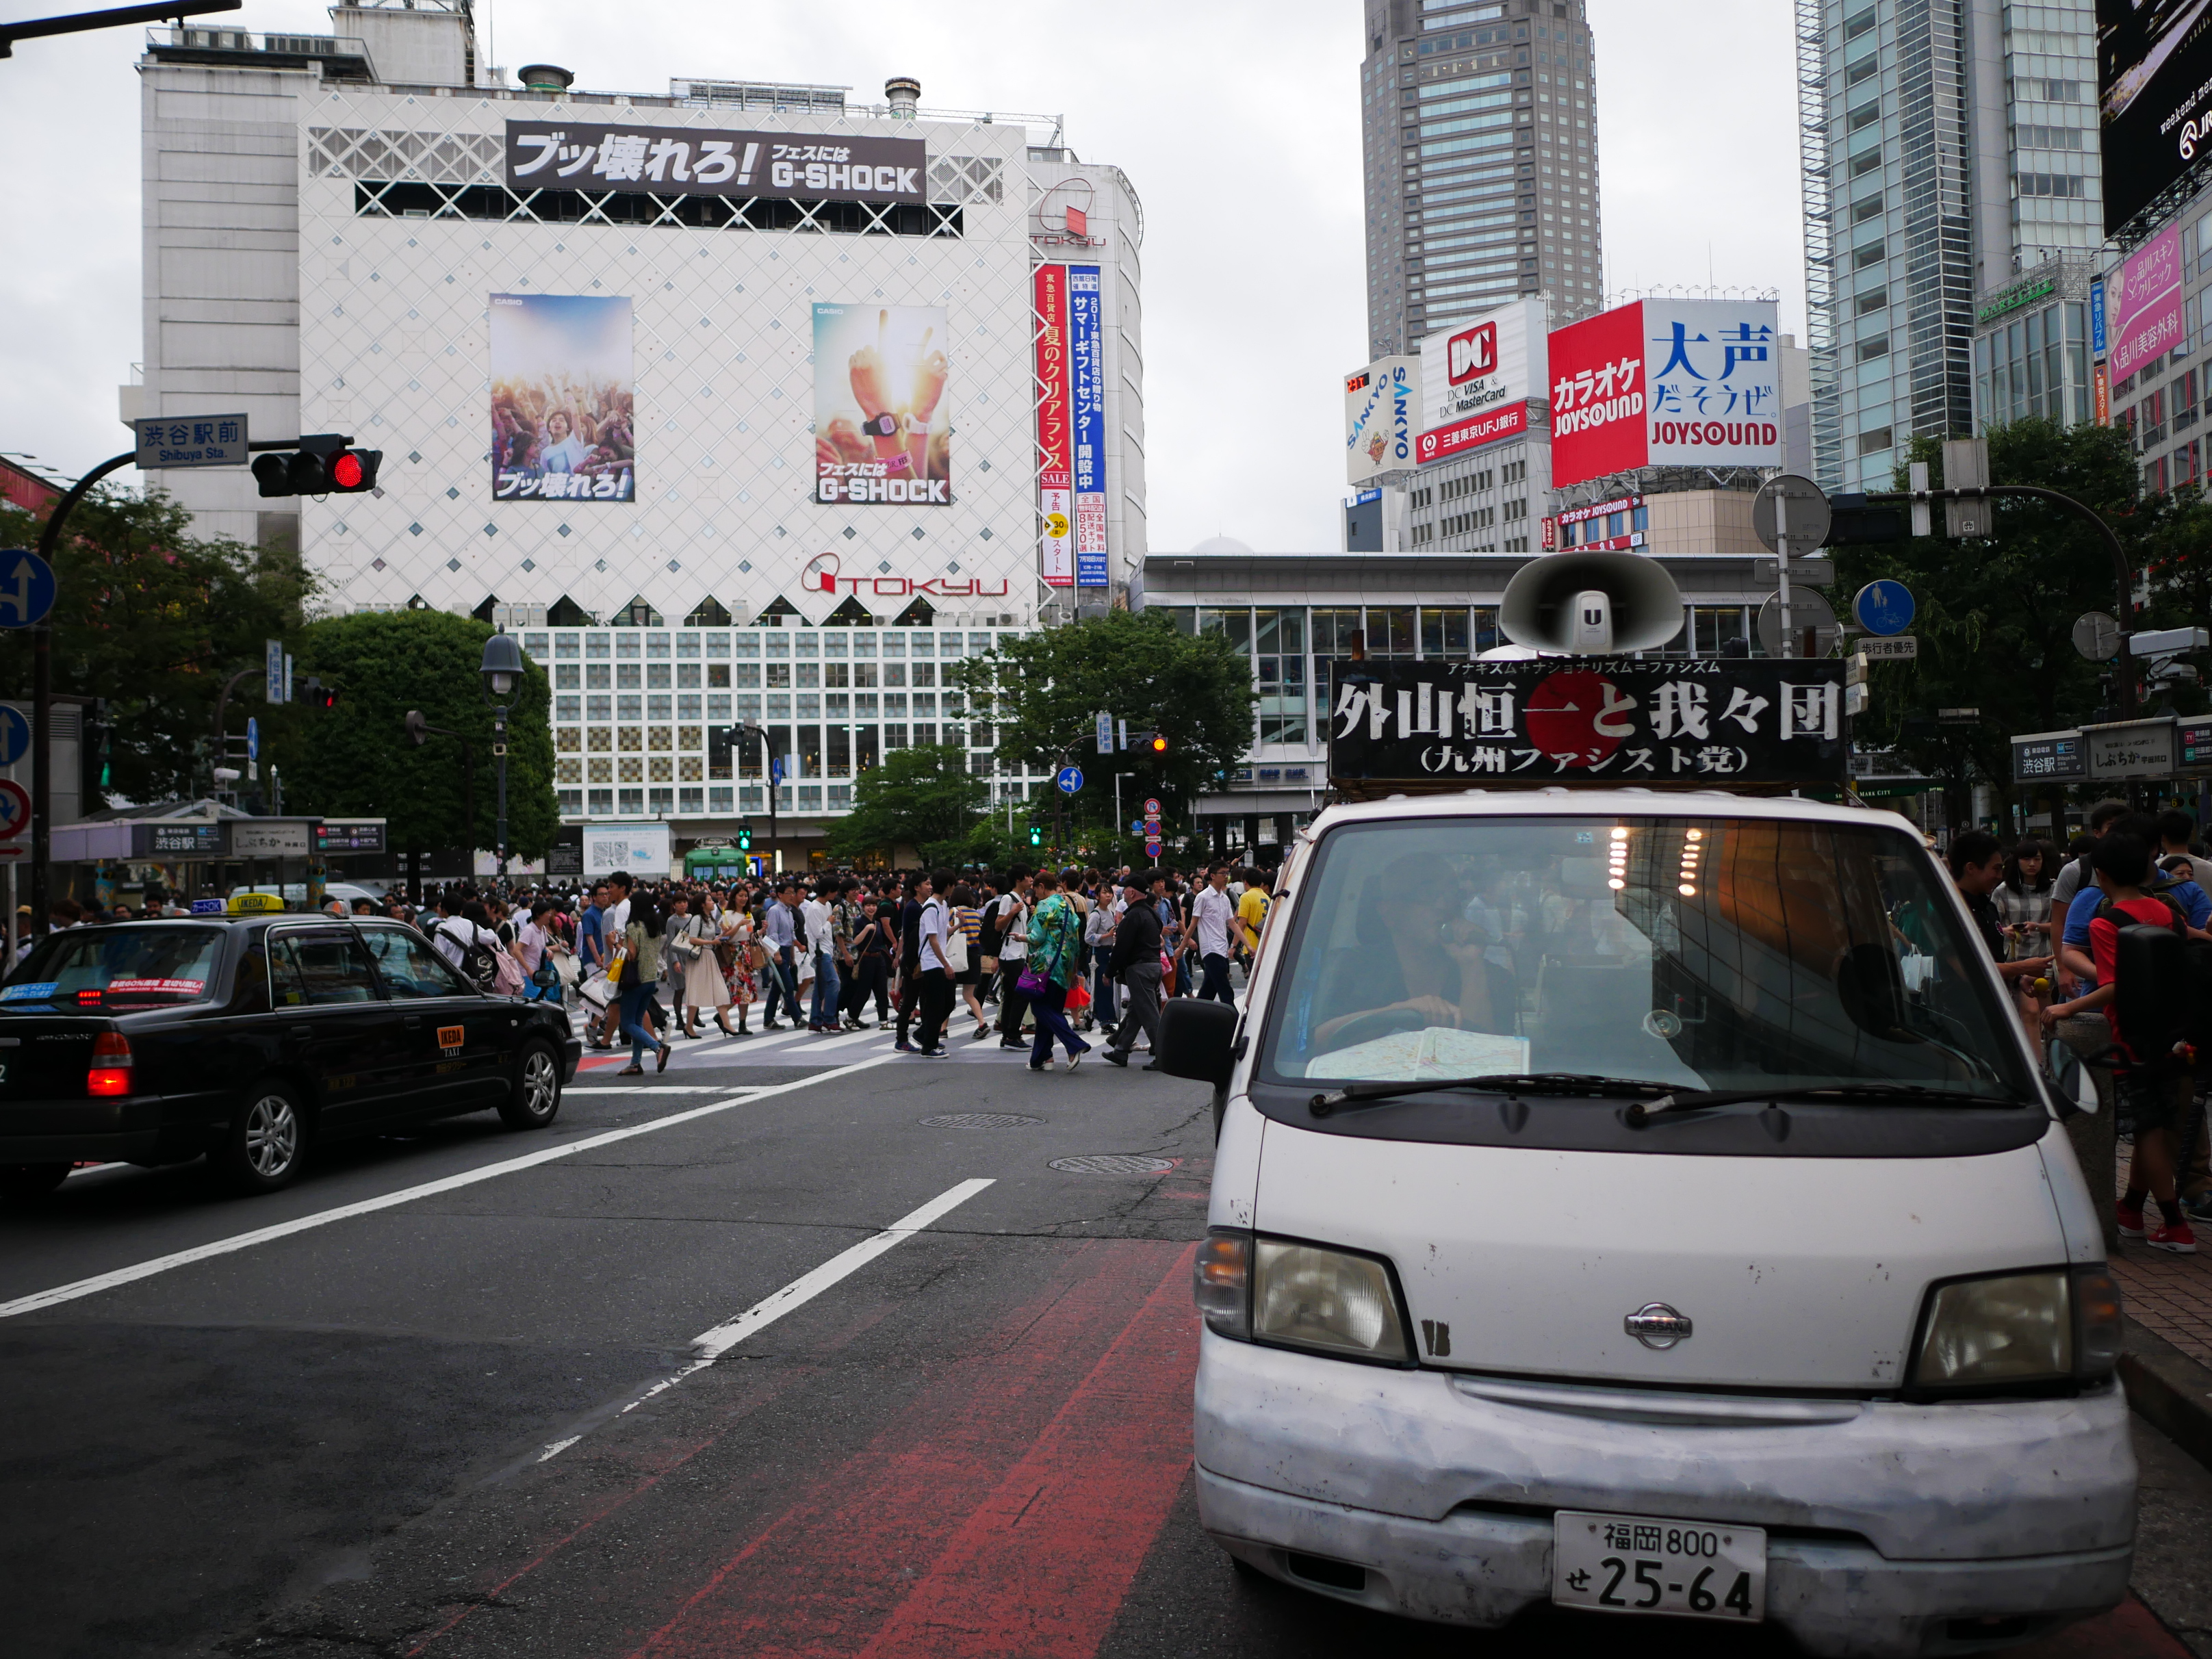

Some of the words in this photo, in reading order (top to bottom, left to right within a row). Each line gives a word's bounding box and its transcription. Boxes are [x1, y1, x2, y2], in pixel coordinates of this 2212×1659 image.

[2160, 90, 2196, 135] weekend
[513, 131, 758, 186] ブッ壊れろ!
[771, 144, 849, 162] フェスには
[772, 162, 918, 193] G-SHOCK
[2137, 240, 2175, 281] 品川スキン
[2139, 263, 2172, 301] クリニック
[1045, 274, 1055, 322] 東急百貨店
[1979, 294, 2016, 318] MARK
[2018, 278, 2052, 300] CITY
[2094, 292, 2103, 348] 東急リバブル
[1450, 328, 1491, 378] DC
[1651, 320, 1773, 381] 大声
[2120, 309, 2178, 370] 品川美容外科
[1073, 296, 1093, 489] サマーギフトセンター開設中
[1447, 387, 1462, 402] DC
[1463, 378, 1484, 396] VISA
[1491, 376, 1497, 385] &
[1554, 357, 1641, 413] カラオケ
[1347, 374, 1388, 450] SANKYO
[1393, 366, 1413, 459] SANKYO
[1439, 404, 1453, 418] DC
[1456, 385, 1506, 413] MasterCard
[1554, 391, 1643, 438] JOYSOUND
[1651, 384, 1777, 418] だそうぜ。
[144, 421, 239, 448] 渋谷駅前
[1443, 411, 1519, 448] 三菱東京UFJ銀行
[1651, 421, 1777, 446] JOYSOUND
[159, 448, 203, 463] Shibuya
[205, 447, 228, 459] Sta.
[819, 462, 888, 478] フェスには
[496, 472, 629, 499] ブッ壊れろ!
[819, 478, 947, 502] G-SHOCK
[1041, 474, 1070, 483] SALE
[1051, 492, 1061, 511] 予告
[1561, 507, 1591, 524] カラオケ
[1591, 498, 1628, 517] JOYSOUND
[1096, 513, 1105, 552] 全国無料
[1632, 535, 1641, 544] 8F
[1053, 539, 1062, 573] スタート
[838, 578, 1008, 596] TOKYU
[1584, 609, 1602, 626] U
[1861, 641, 1915, 654] 歩行者優先
[1333, 680, 1841, 741] 外山恒一と我々団
[1421, 745, 1749, 775] (九州ファシスト党)
[2023, 756, 2055, 774] 渋谷駅
[2096, 751, 2139, 768] しぶちか
[2141, 755, 2167, 764] 宇田川口
[155, 837, 195, 849] 渋谷駅
[240, 898, 263, 908] IKEDA
[441, 1029, 461, 1045] IKEDA
[444, 1047, 460, 1057] TAXI
[1633, 1320, 1684, 1332] NISSAN
[1603, 1522, 1662, 1553] 福岡
[1666, 1528, 1718, 1558] 800
[1565, 1567, 1592, 1592] せ
[1599, 1556, 1753, 1616] 25-64
